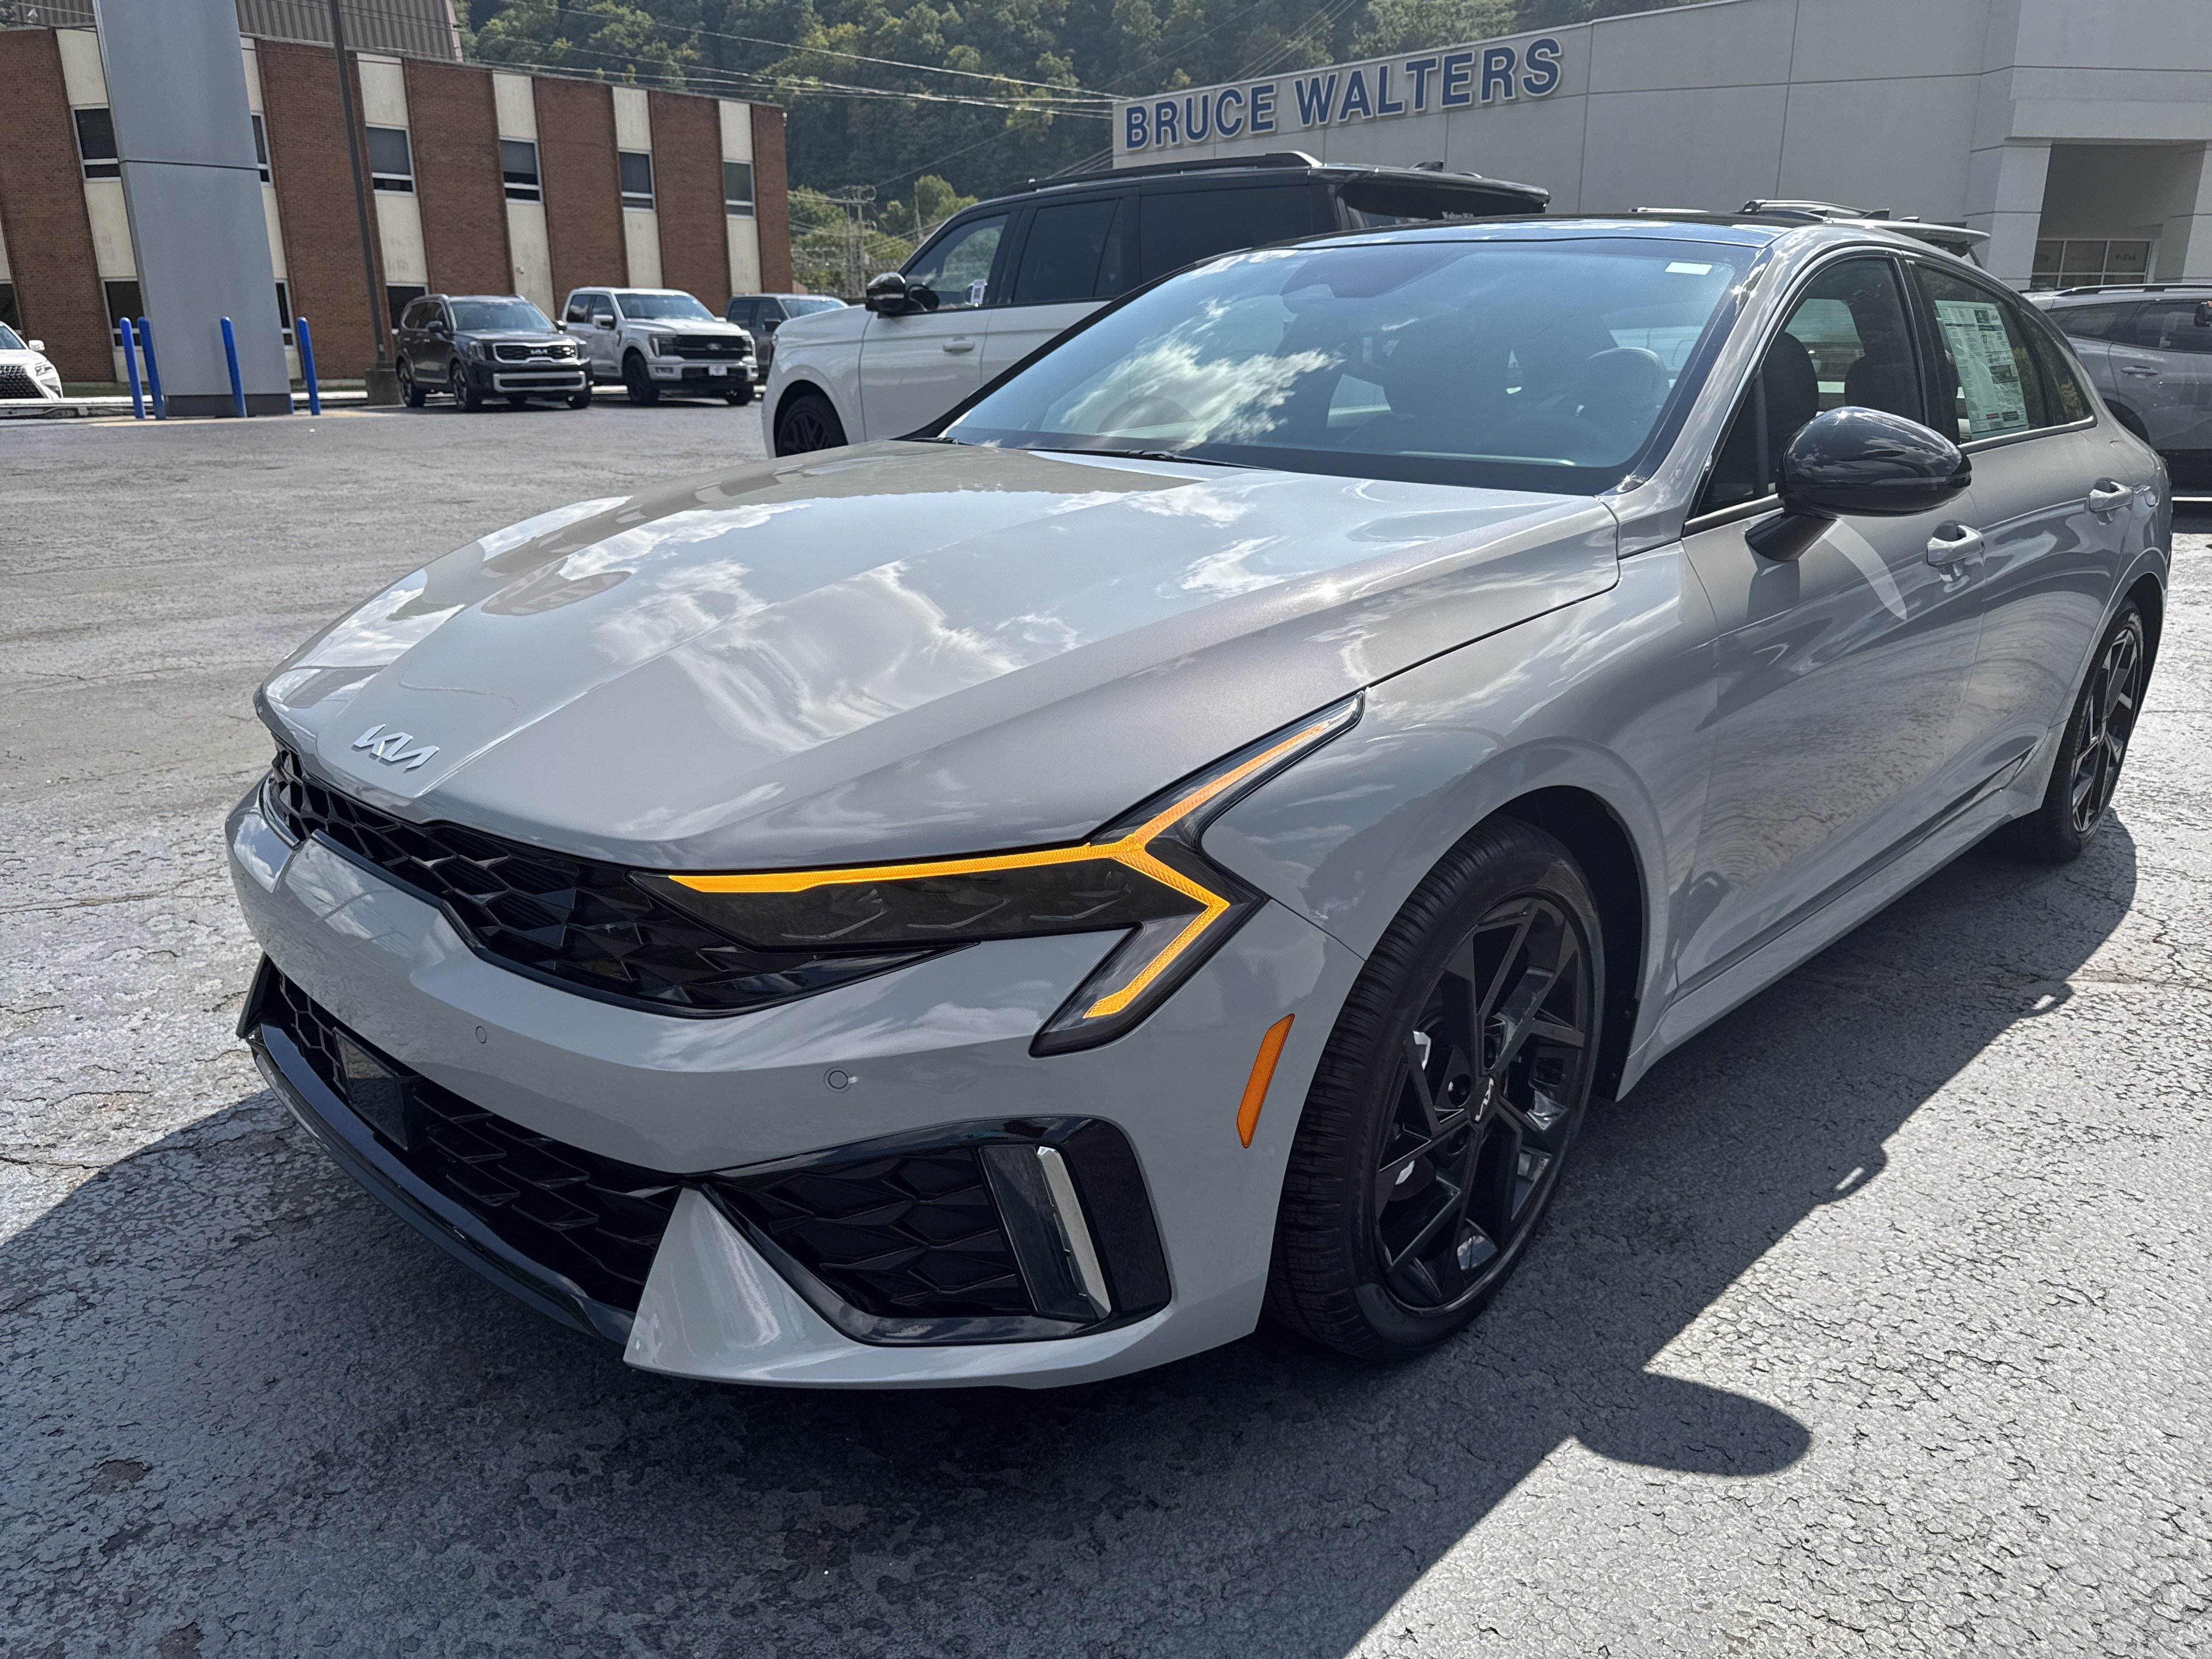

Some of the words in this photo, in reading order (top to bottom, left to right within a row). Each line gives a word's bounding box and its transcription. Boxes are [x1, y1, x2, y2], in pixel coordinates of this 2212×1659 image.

[1125, 84, 1274, 149] BRUCE
[1294, 38, 1560, 125] WALTERS
[353, 723, 439, 771] KIA
